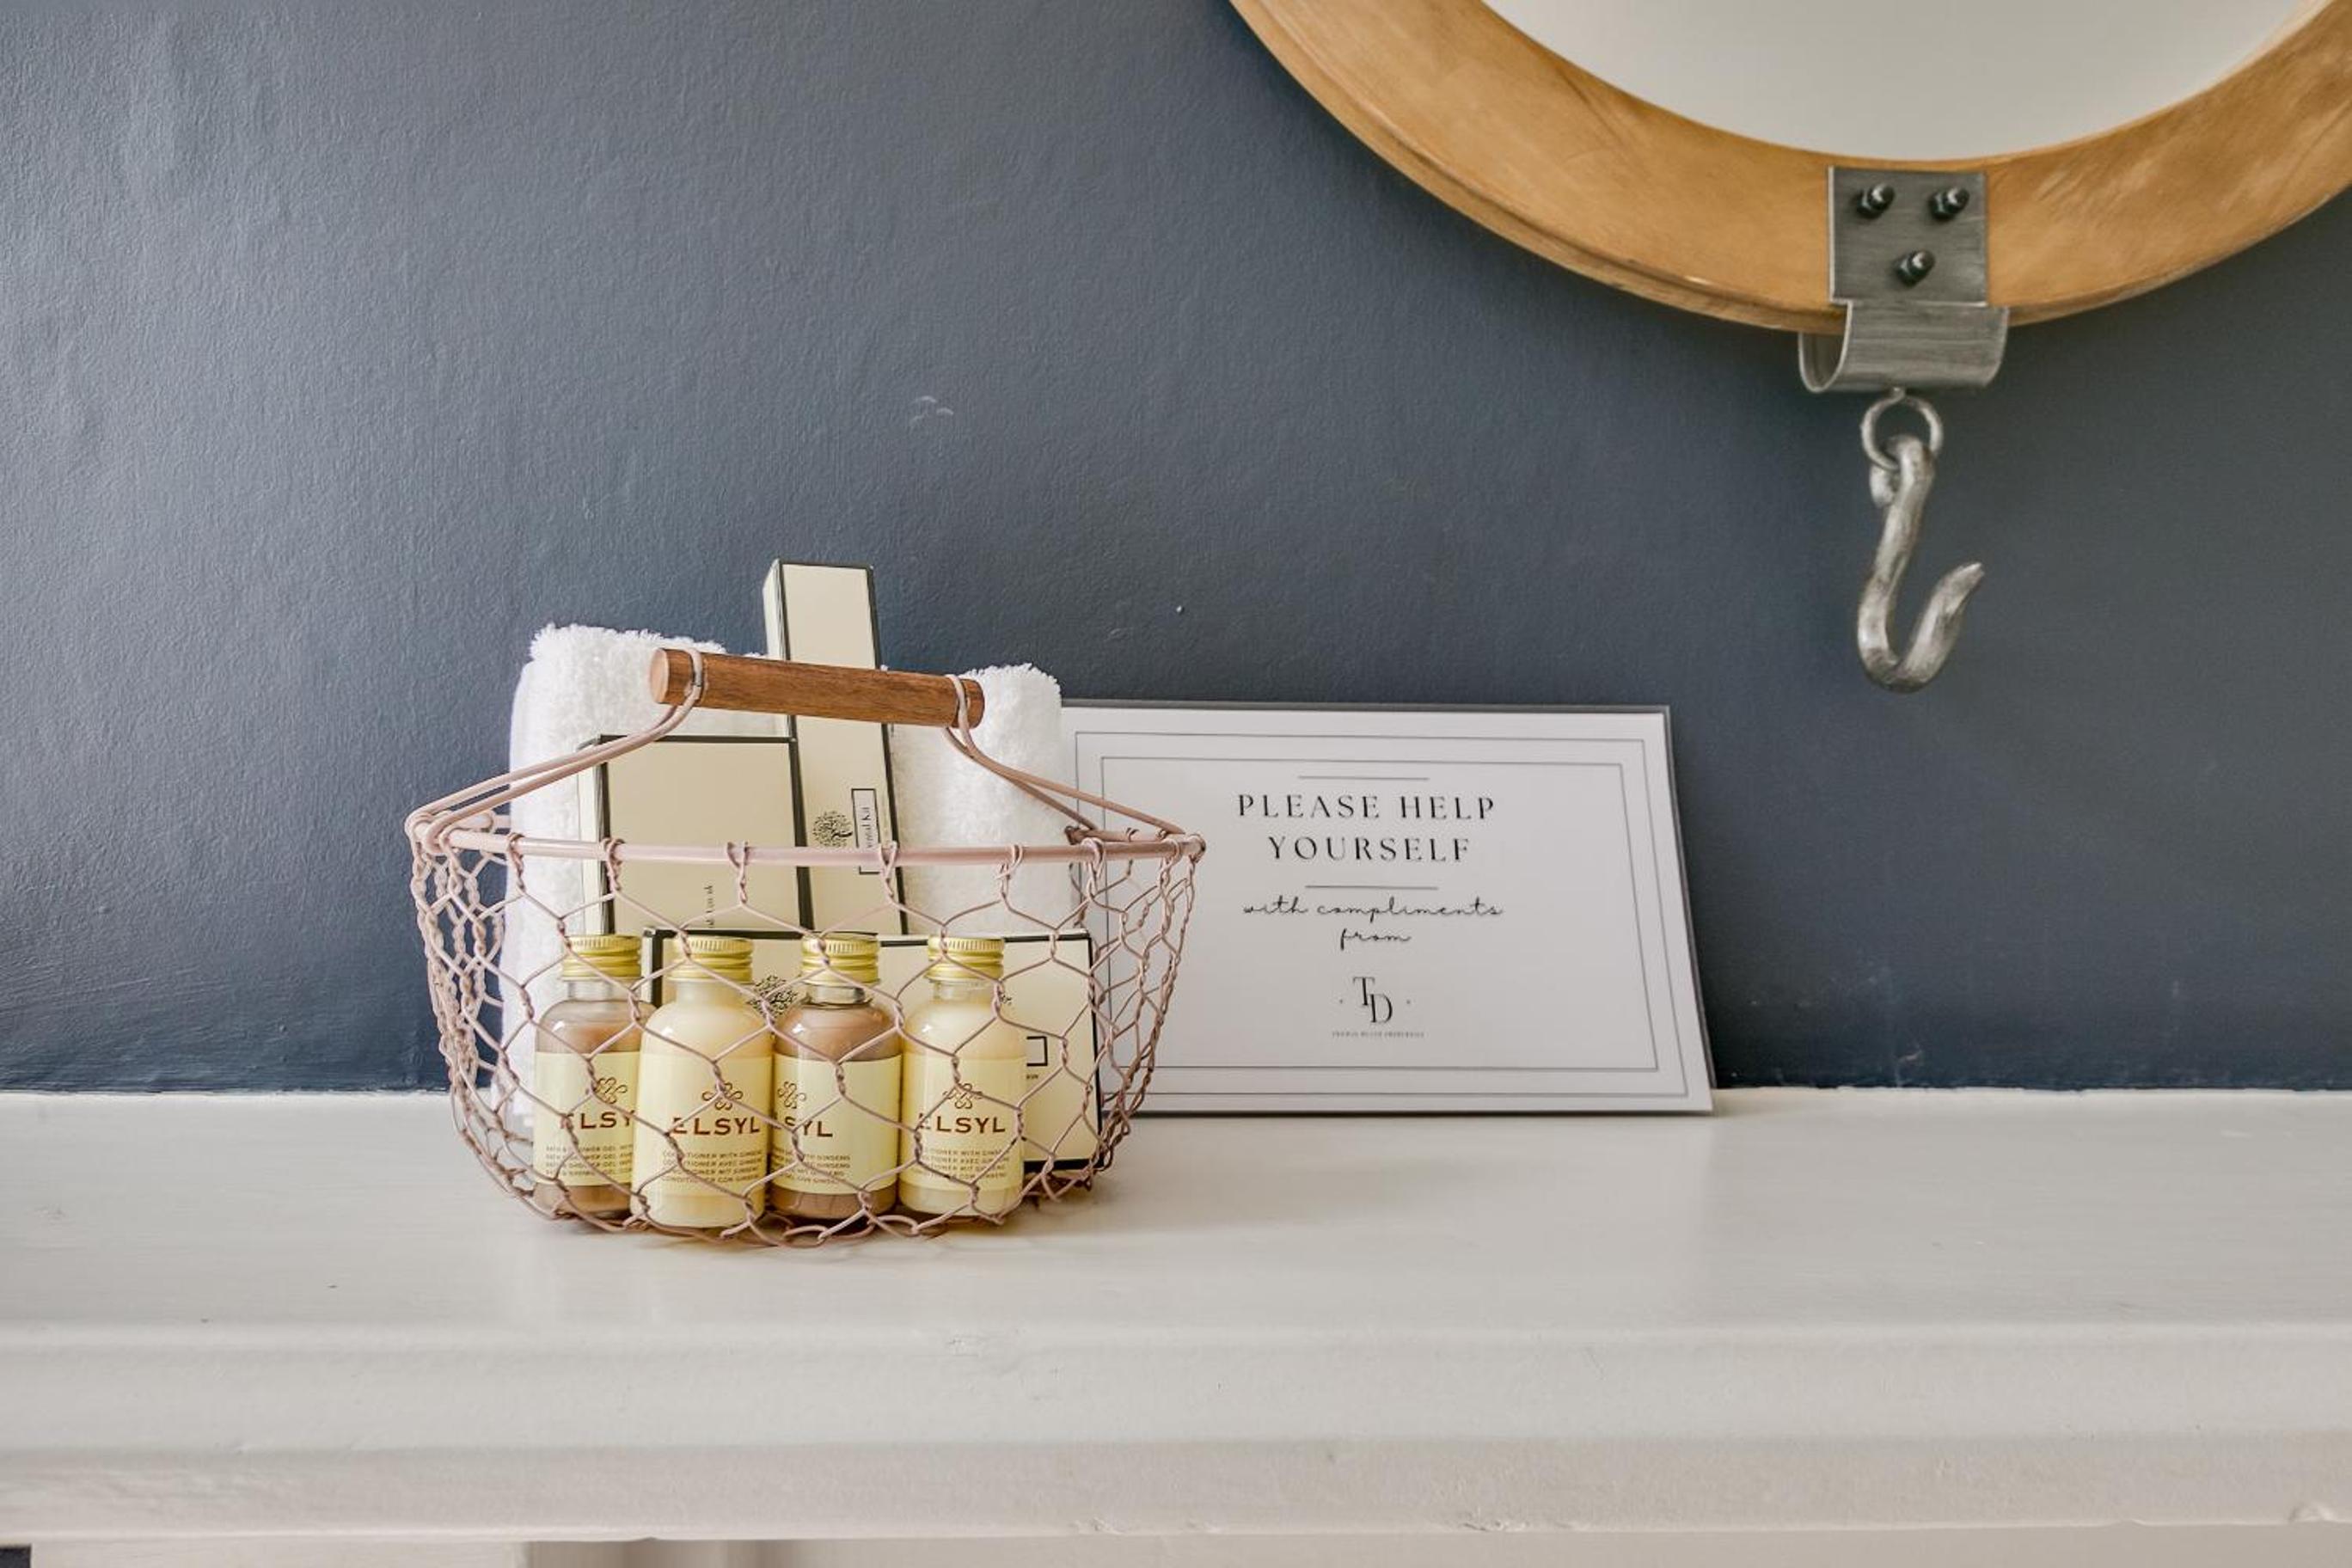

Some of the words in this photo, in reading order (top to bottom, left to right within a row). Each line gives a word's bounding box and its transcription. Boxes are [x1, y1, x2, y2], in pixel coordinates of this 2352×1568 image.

[1237, 793, 1381, 820] PLEASE
[1399, 795, 1496, 820] HELP
[1267, 836, 1471, 862] YOURSELF
[1242, 895, 1309, 916] with
[1315, 896, 1504, 923] compliments
[1338, 928, 1412, 952] from
